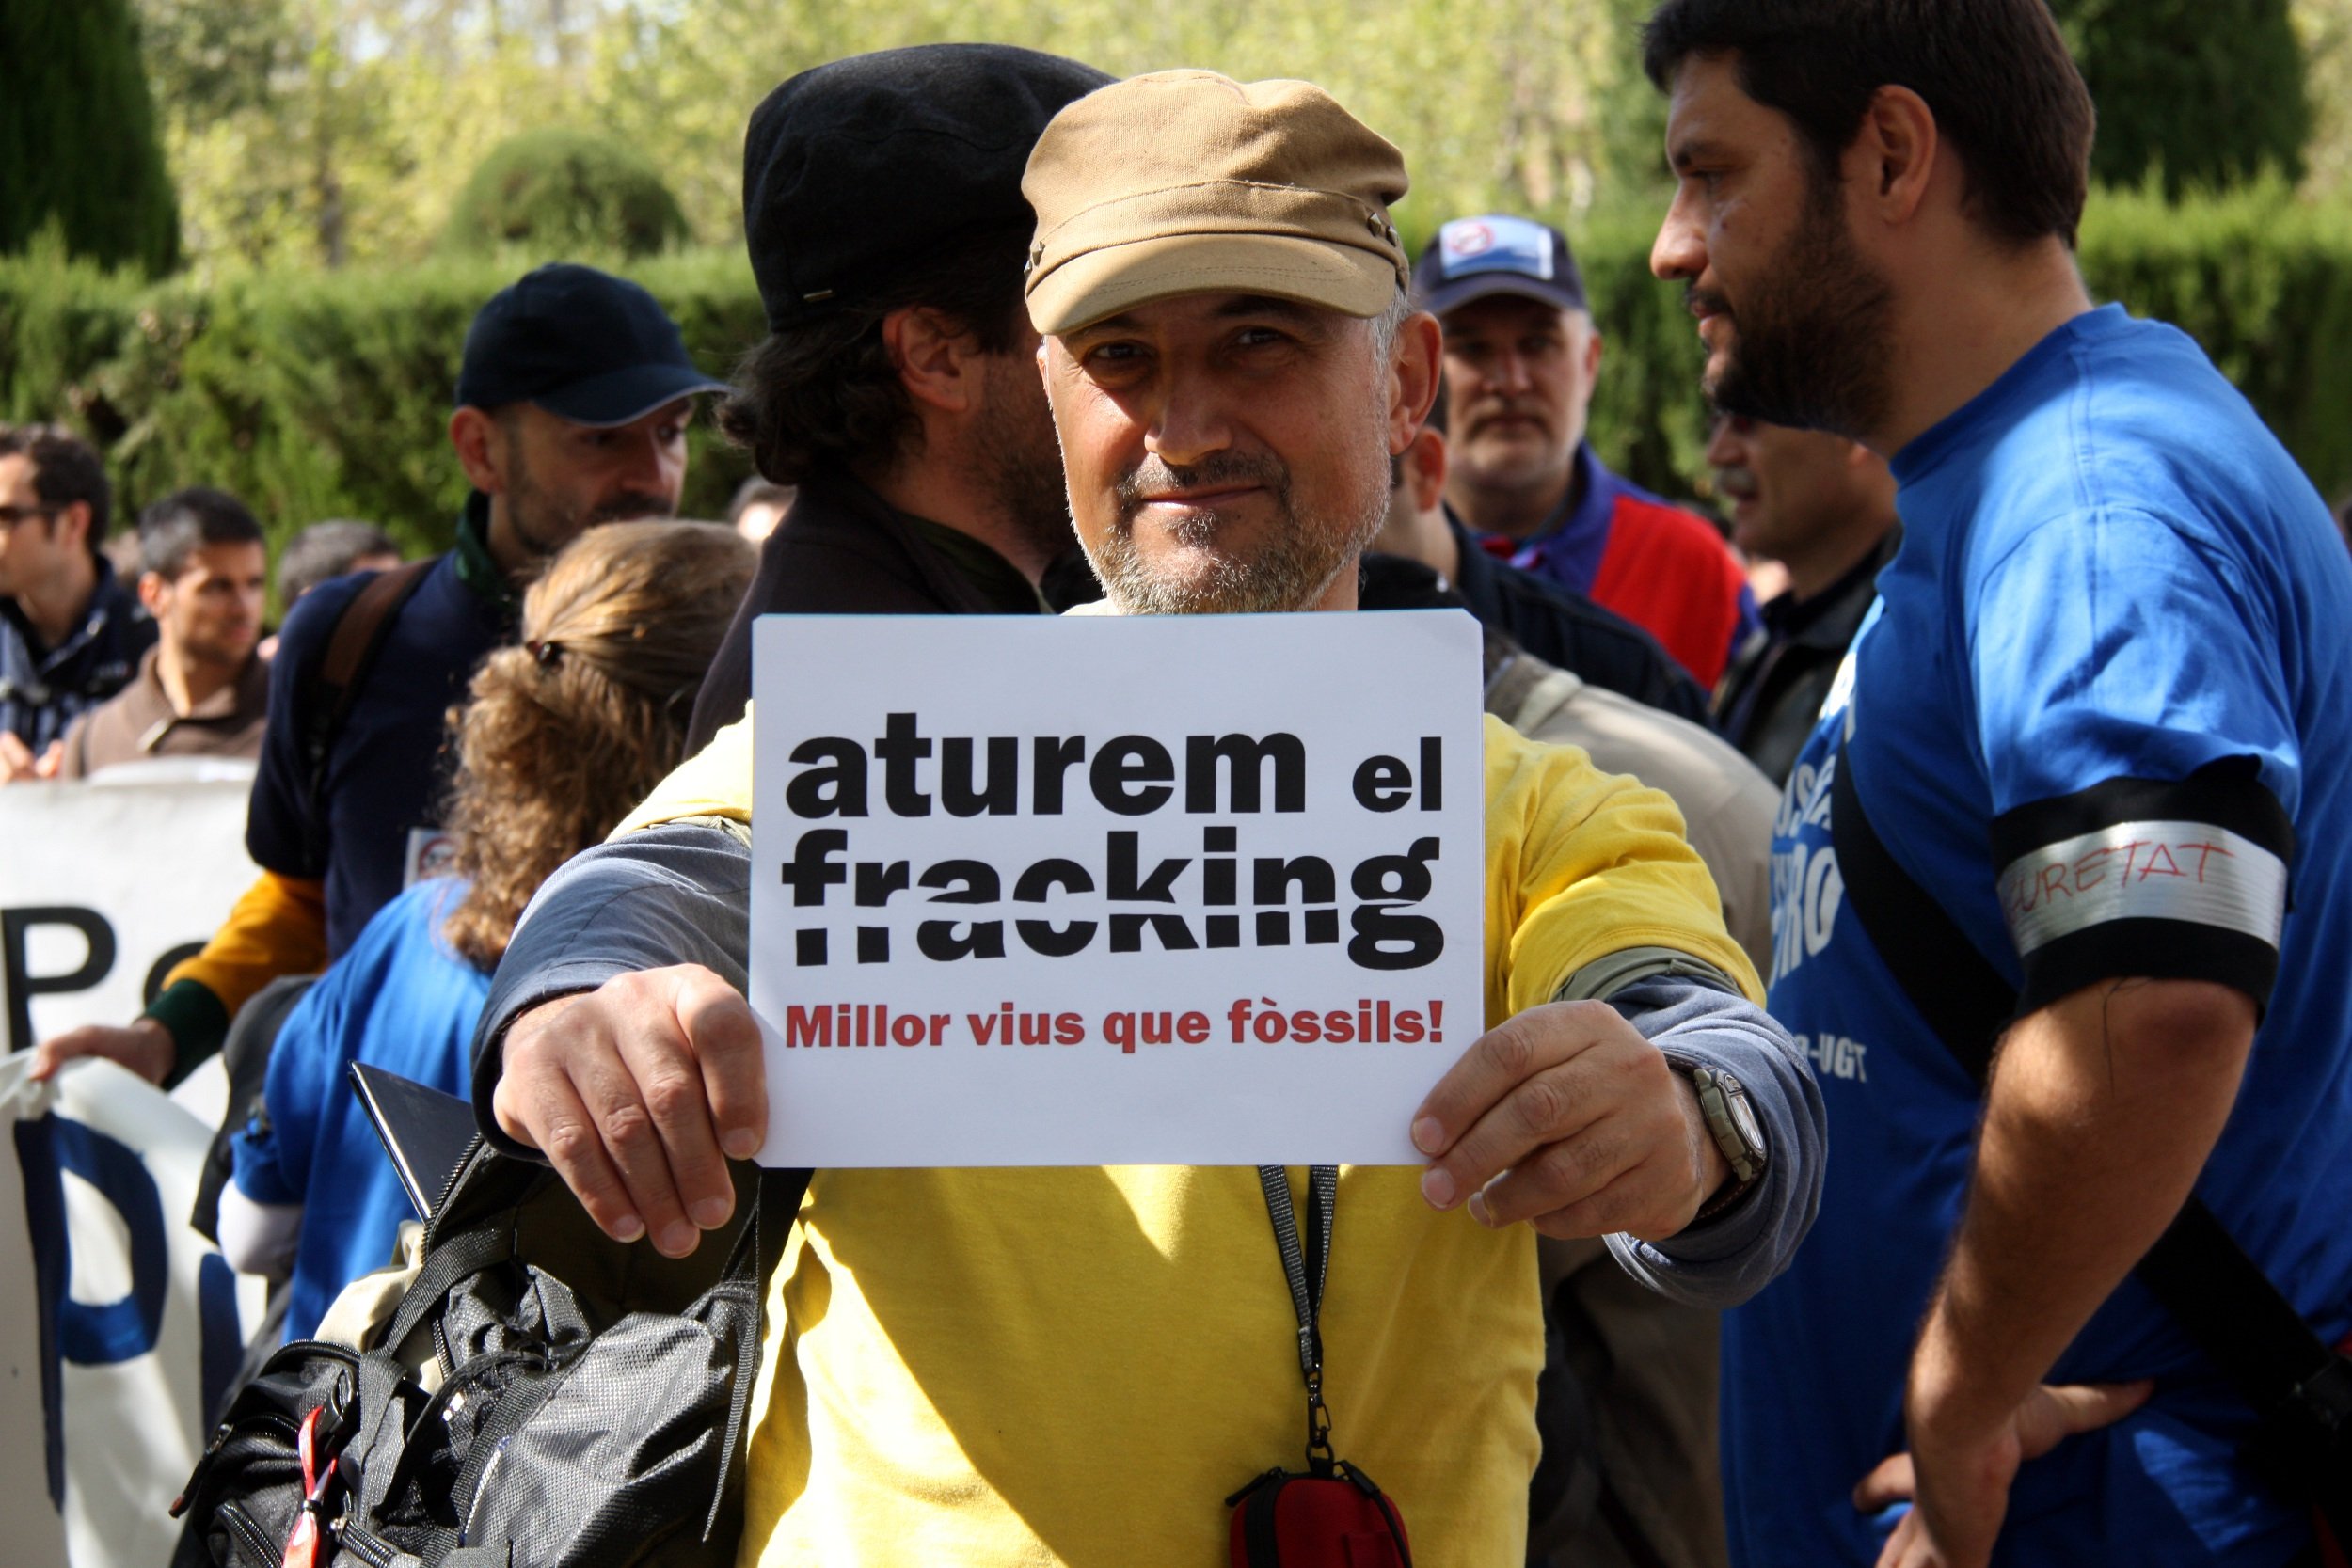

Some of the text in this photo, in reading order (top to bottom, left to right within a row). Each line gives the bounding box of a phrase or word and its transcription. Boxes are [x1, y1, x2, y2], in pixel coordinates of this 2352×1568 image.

[786, 712, 1442, 818] aturem el
[782, 826, 1445, 970] fracking
[787, 998, 1442, 1053] Millor vius que fòssils!
